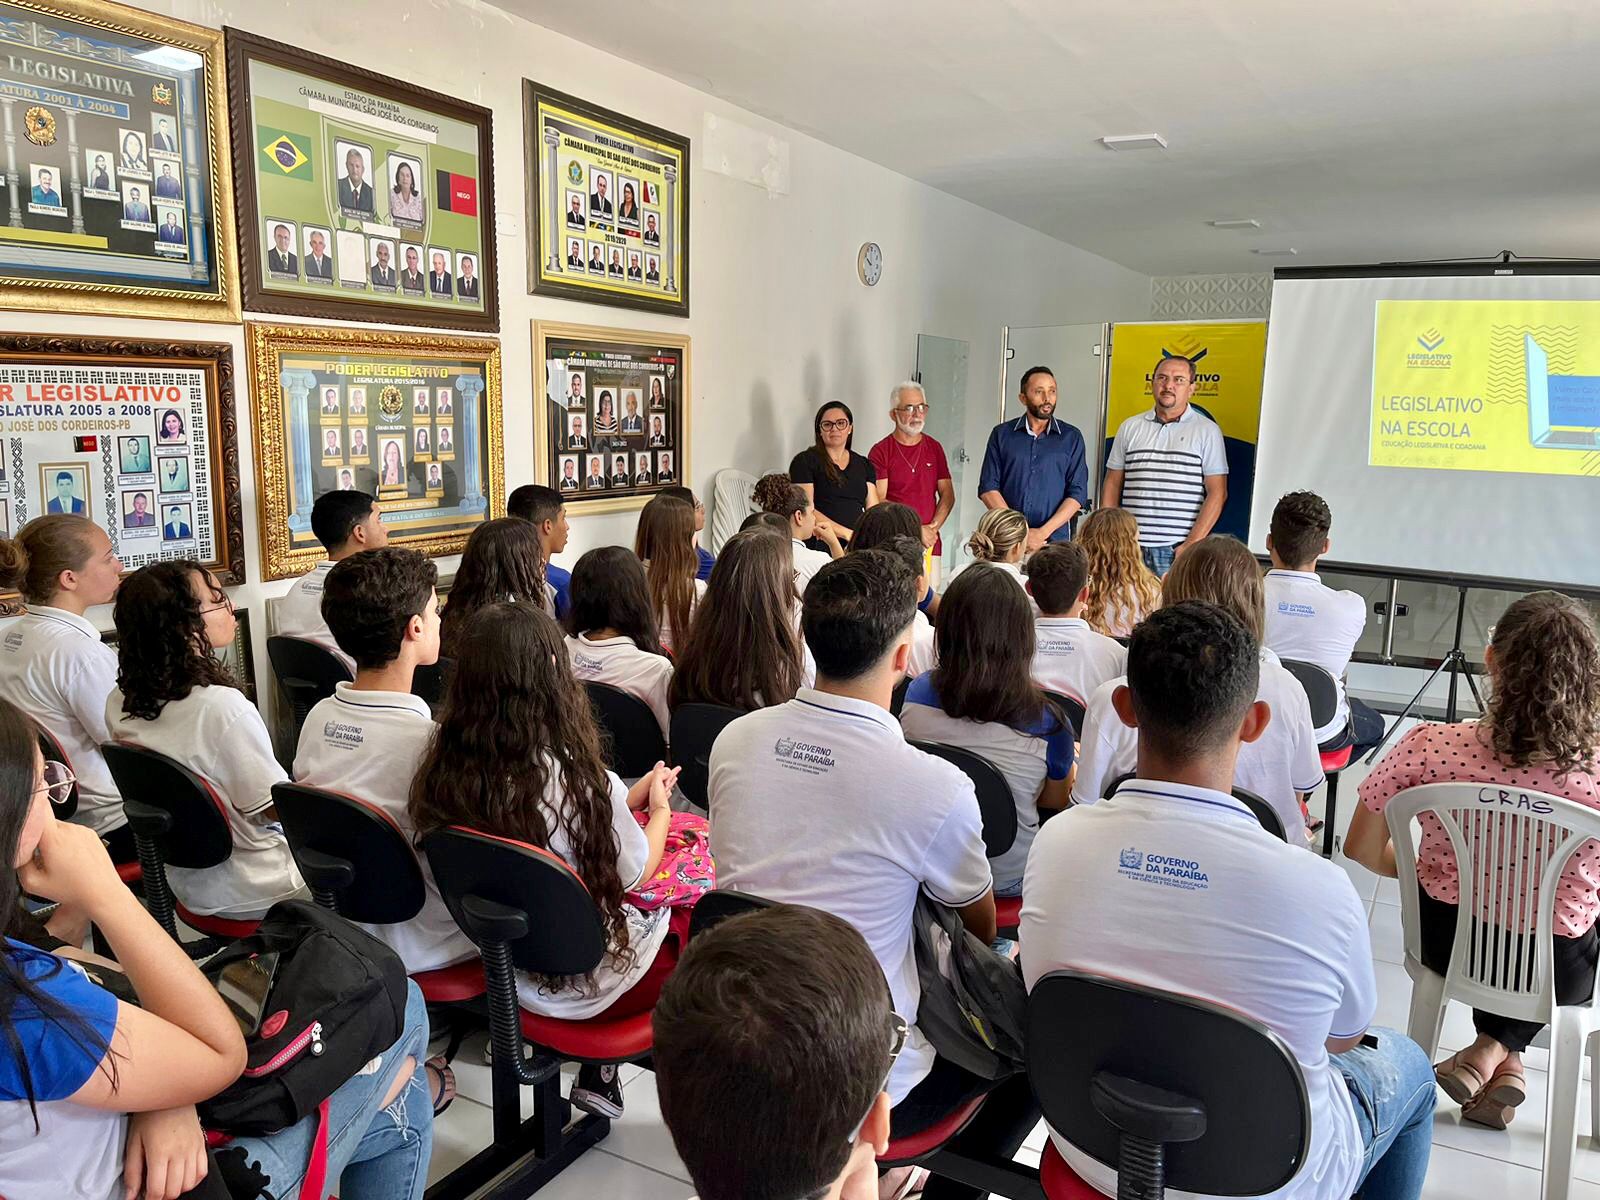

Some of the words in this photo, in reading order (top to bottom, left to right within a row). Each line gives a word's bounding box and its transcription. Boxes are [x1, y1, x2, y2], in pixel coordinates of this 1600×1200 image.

[8, 55, 136, 97] LEGISLATIVA
[43, 92, 73, 106] 2001
[88, 101, 117, 114] 2004
[344, 90, 367, 104] ESTADO
[368, 99, 376, 107] DA
[298, 86, 327, 102] CÂMARA
[328, 95, 362, 112] MUNICIPAL
[393, 114, 406, 125] DOS
[407, 118, 439, 134] CORDEIROS
[584, 143, 606, 158] MUNICIPAL
[456, 191, 471, 200] NEGO
[325, 363, 371, 376] PODER
[373, 365, 449, 379] LEGISLATIVO
[26, 384, 181, 403] LEGISLATIVO
[70, 404, 102, 416] 2005
[108, 407, 116, 416] a
[121, 404, 152, 416] 2008
[1381, 395, 1483, 413] LEGISLATIVO
[8, 418, 34, 432] JOSÉ
[38, 420, 58, 432] DOS
[62, 419, 131, 431] CORDEIROS-PB
[1380, 420, 1403, 435] NA
[1407, 420, 1471, 438] ESCOLA
[796, 742, 832, 757] GOVERNO
[792, 751, 803, 760] DA
[803, 753, 836, 767] PARAÍBA
[1478, 787, 1554, 814] CRAS
[1146, 853, 1199, 870] GOVERNO
[1145, 863, 1161, 874] DA
[1163, 866, 1209, 882] PARAÍBA
